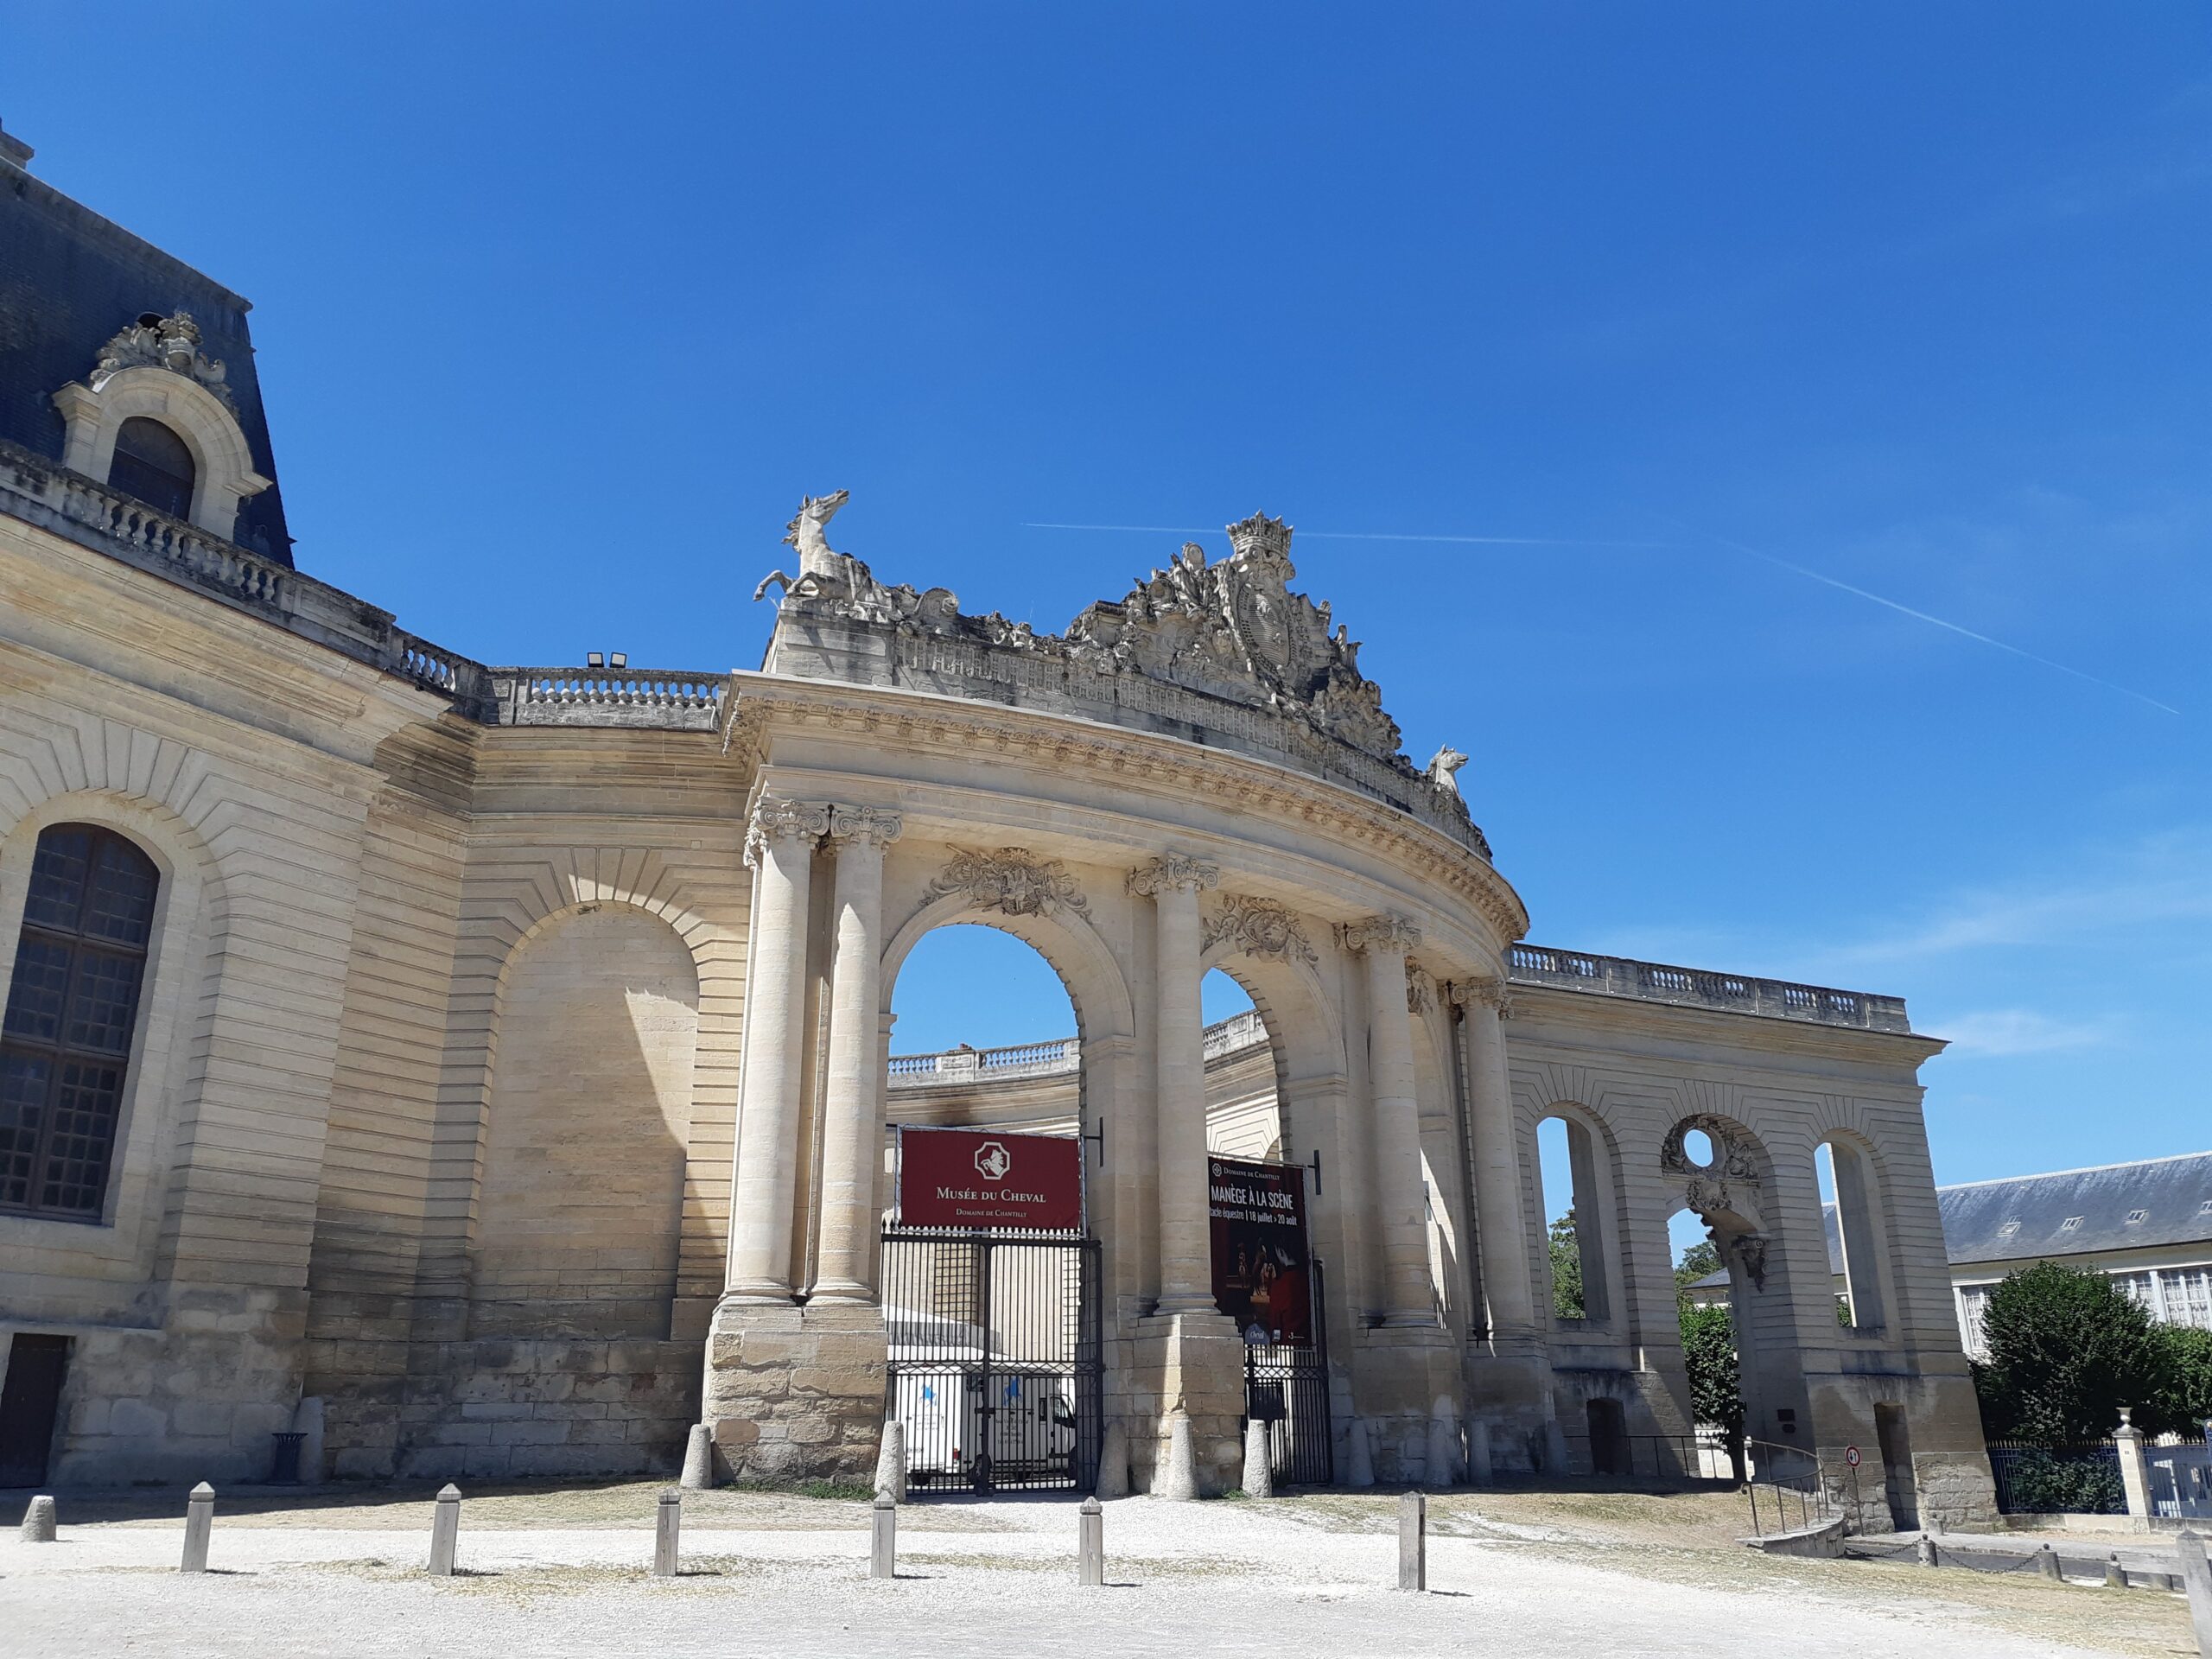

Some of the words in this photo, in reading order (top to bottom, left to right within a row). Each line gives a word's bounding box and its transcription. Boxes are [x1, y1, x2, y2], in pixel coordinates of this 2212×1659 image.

[1224, 1167, 1246, 1176] DOMAINE
[1255, 1171, 1280, 1180] CHANTILLY
[936, 1187, 977, 1200] MUSÉE
[981, 1192, 997, 1201] DU
[1001, 1189, 1046, 1203] CHEVAL
[1211, 1183, 1247, 1205] MANÈGE
[1249, 1185, 1255, 1205] À
[1256, 1191, 1267, 1207] LA
[1268, 1189, 1294, 1210] SCÈNE
[995, 1209, 1027, 1217] CHANTILLY
[1209, 1207, 1222, 1217] tacle
[1222, 1208, 1244, 1221] équestre
[1250, 1211, 1257, 1222] 18
[1257, 1211, 1273, 1224] juillet
[1277, 1213, 1286, 1224] 20
[1286, 1215, 1297, 1225] août
